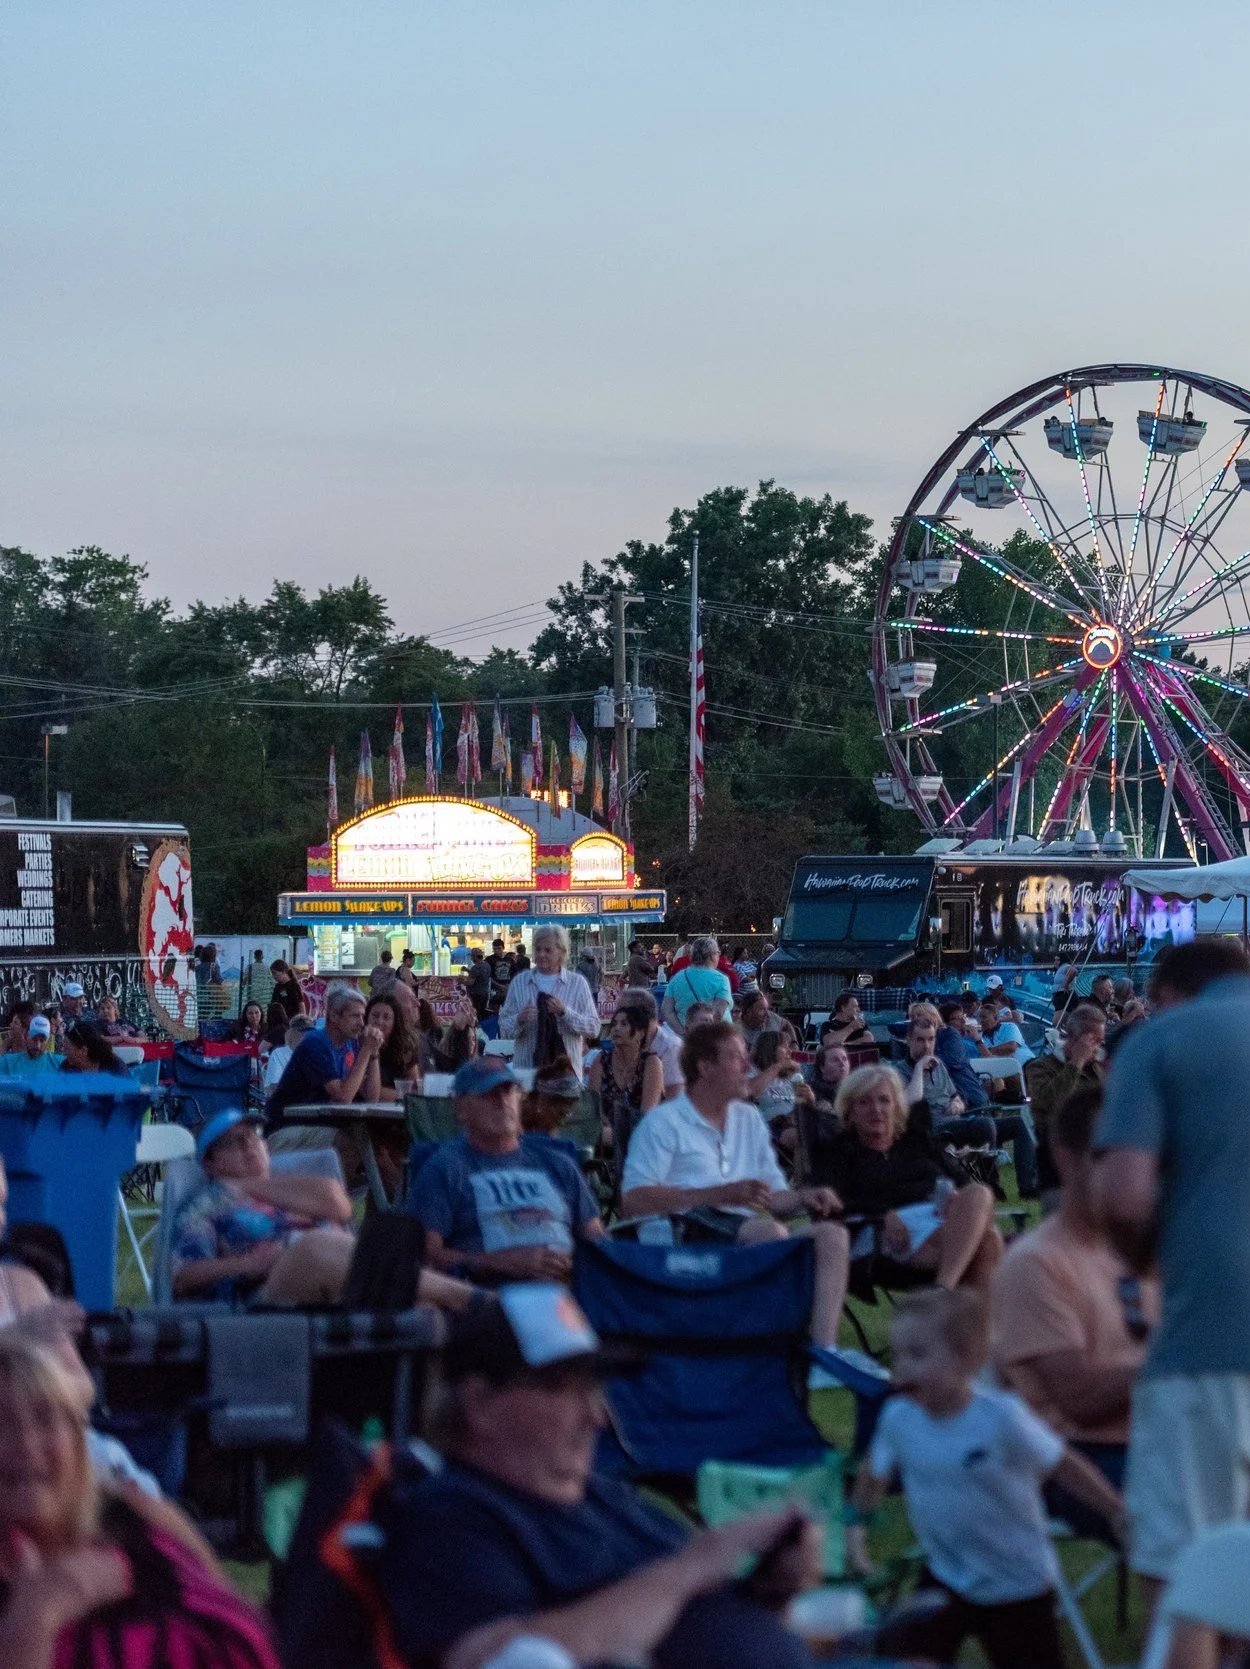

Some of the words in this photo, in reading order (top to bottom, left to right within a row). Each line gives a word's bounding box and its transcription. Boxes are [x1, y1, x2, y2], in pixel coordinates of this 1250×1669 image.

[18, 833, 52, 850] FESTIVALS
[24, 852, 53, 870] PARTIES
[17, 870, 53, 888] WEDDINGS
[21, 890, 54, 908] CATERING
[294, 900, 342, 913] LEMON
[345, 900, 404, 914] SHAKE-UPS
[416, 900, 478, 913] FUNNEL
[481, 899, 529, 912] CAKES
[602, 898, 629, 911] LEMON
[540, 902, 594, 914] DRINKS
[29, 909, 54, 927] EVENTS
[23, 928, 55, 946] MARKETS
